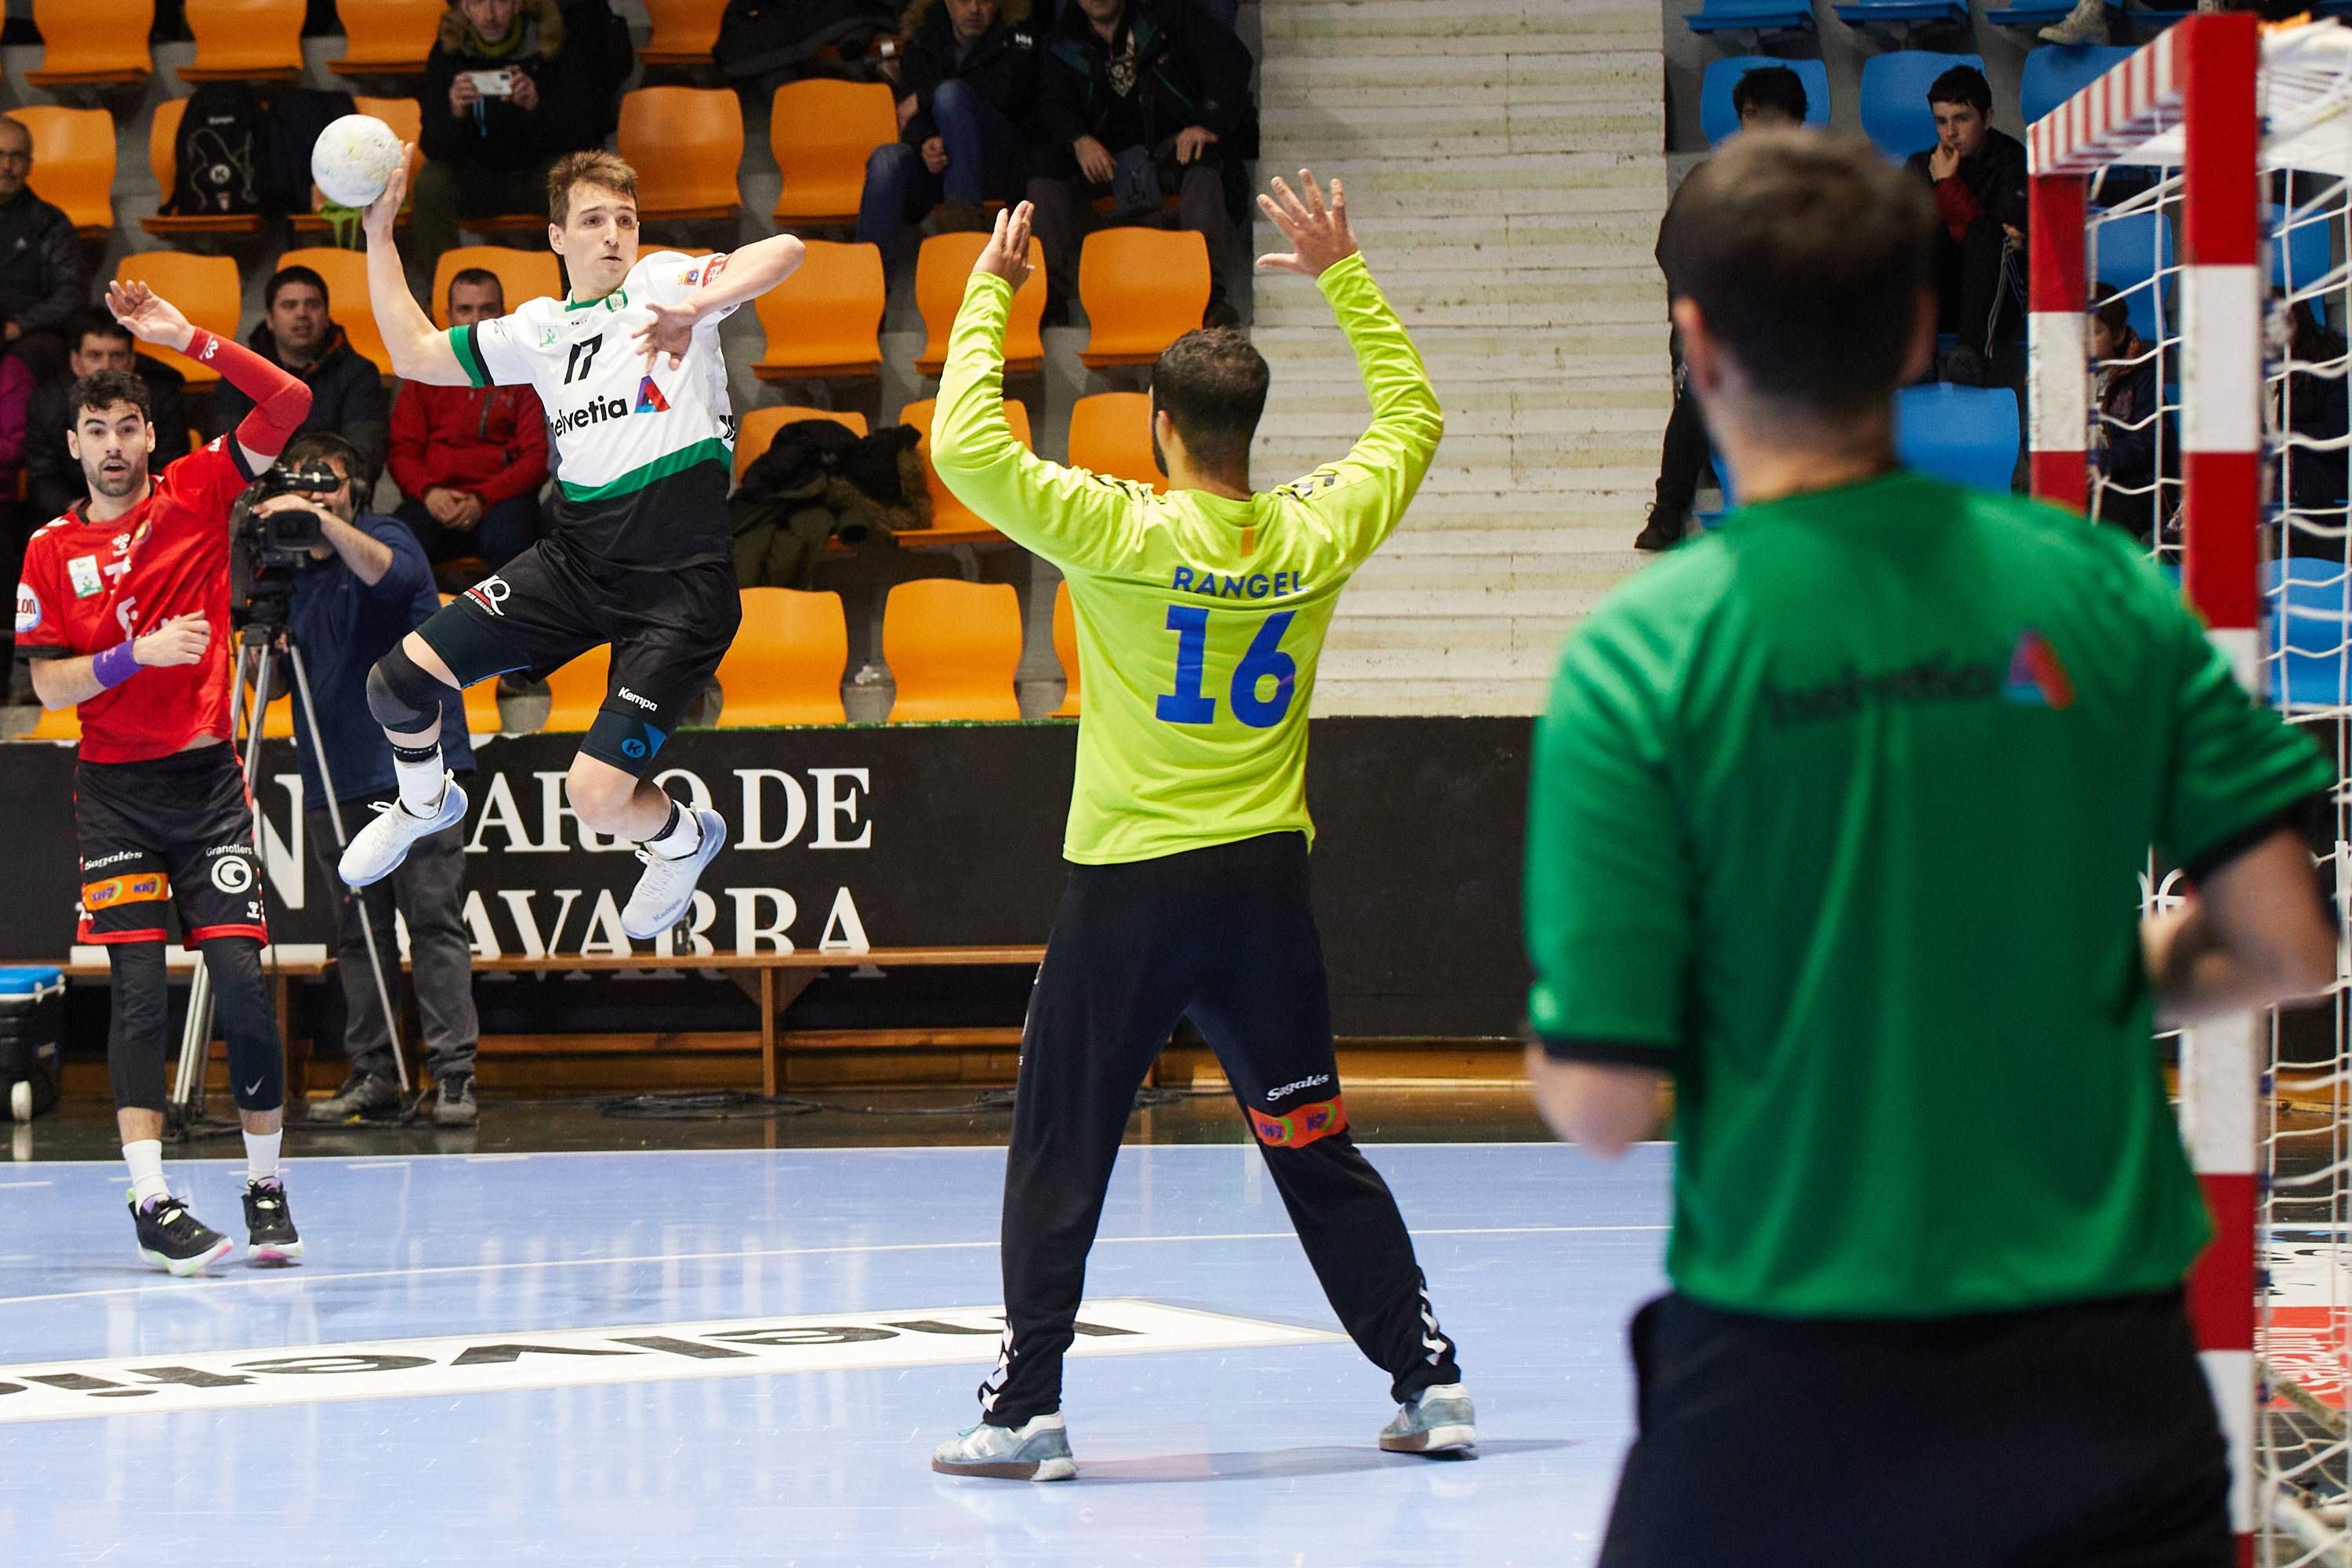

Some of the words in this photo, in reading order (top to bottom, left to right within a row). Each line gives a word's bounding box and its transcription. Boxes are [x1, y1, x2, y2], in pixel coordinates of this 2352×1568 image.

[564, 332, 603, 385] 17
[548, 395, 628, 437] elvetia
[1171, 565, 1312, 599] RANGEL
[1155, 604, 1297, 728] 16
[618, 686, 658, 712] Kempa
[732, 767, 872, 851] DE
[394, 886, 887, 981] AVARRA
[1265, 1074, 1330, 1101] Sagalés
[0, 1316, 1149, 1397] helveti
